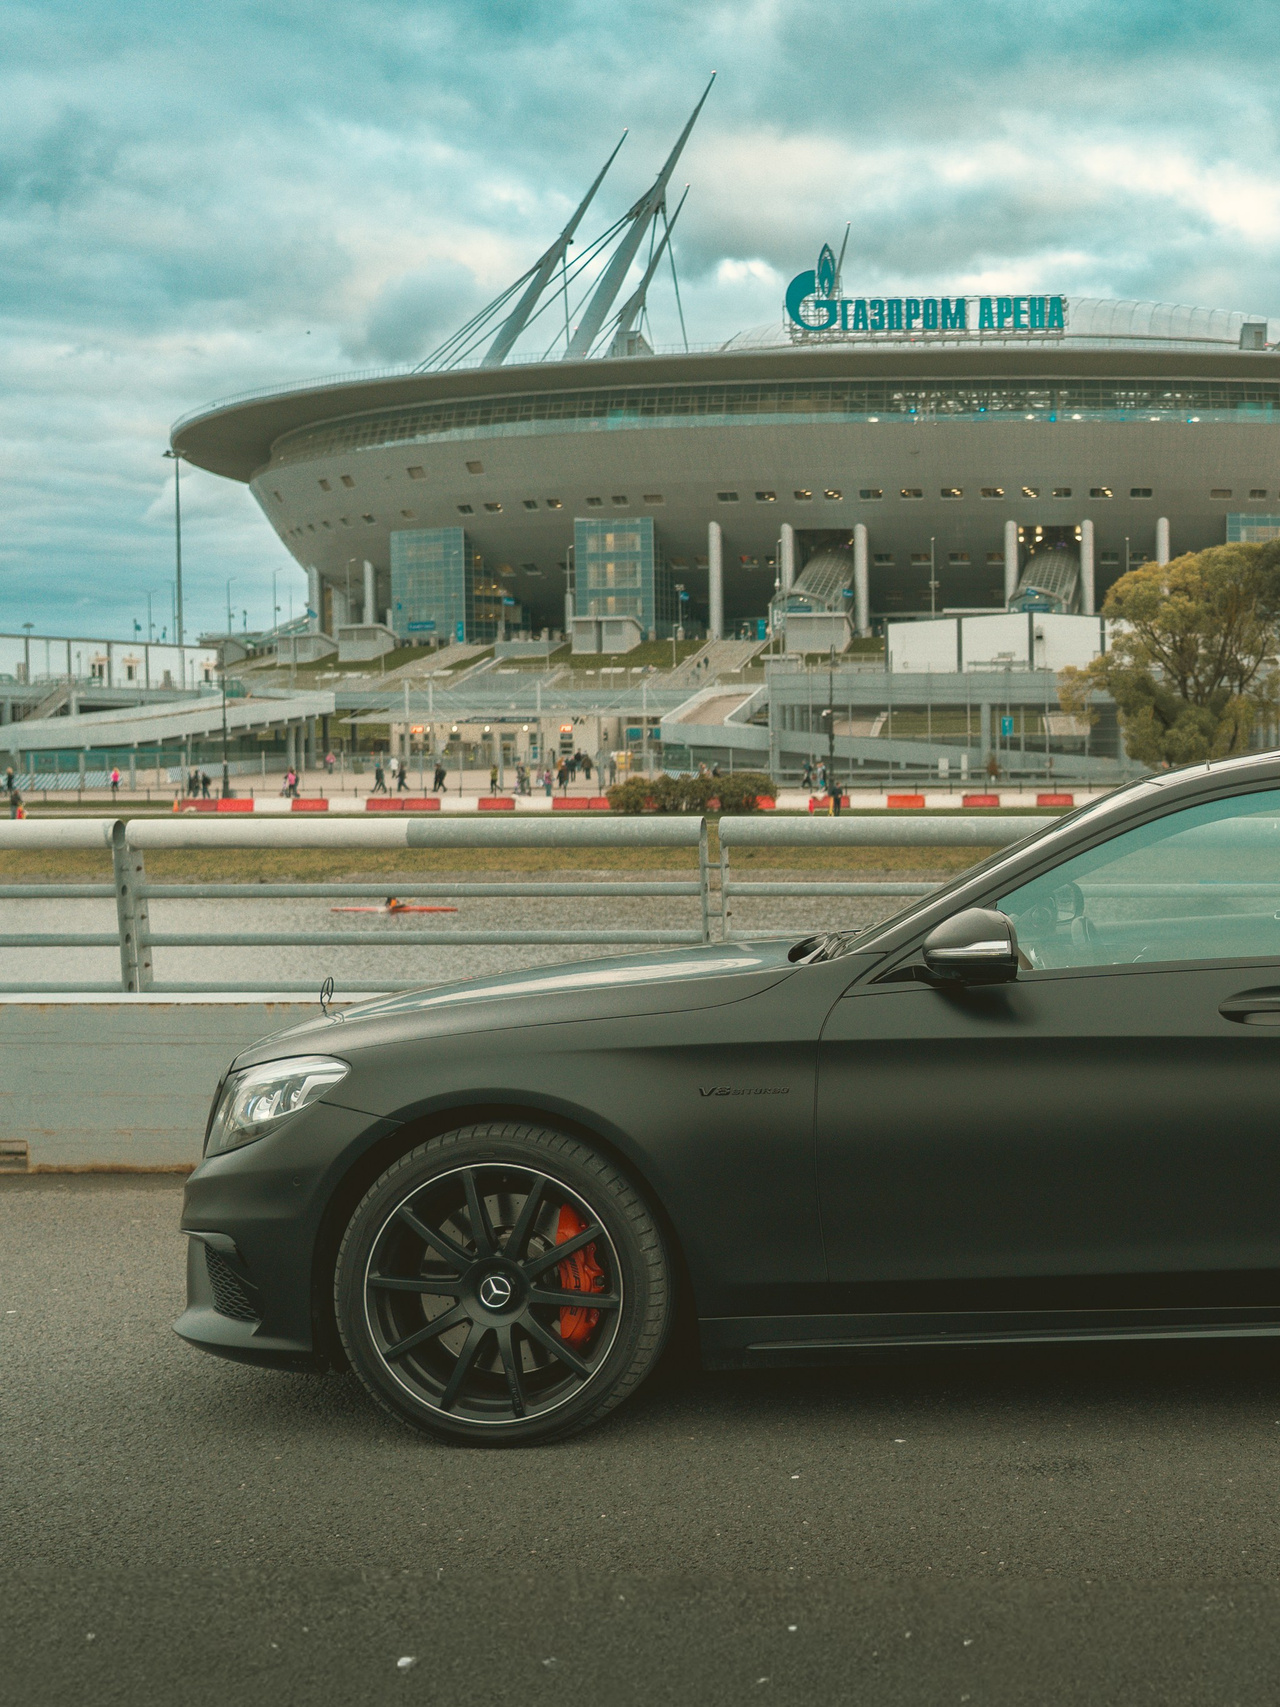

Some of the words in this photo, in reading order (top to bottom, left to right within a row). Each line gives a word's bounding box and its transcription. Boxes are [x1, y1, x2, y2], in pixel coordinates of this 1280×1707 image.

[841, 298, 966, 331] ГАЗПРОМ
[978, 296, 1064, 329] АРЕНА
[699, 1086, 731, 1097] V8
[731, 1087, 790, 1096] BITURBO
